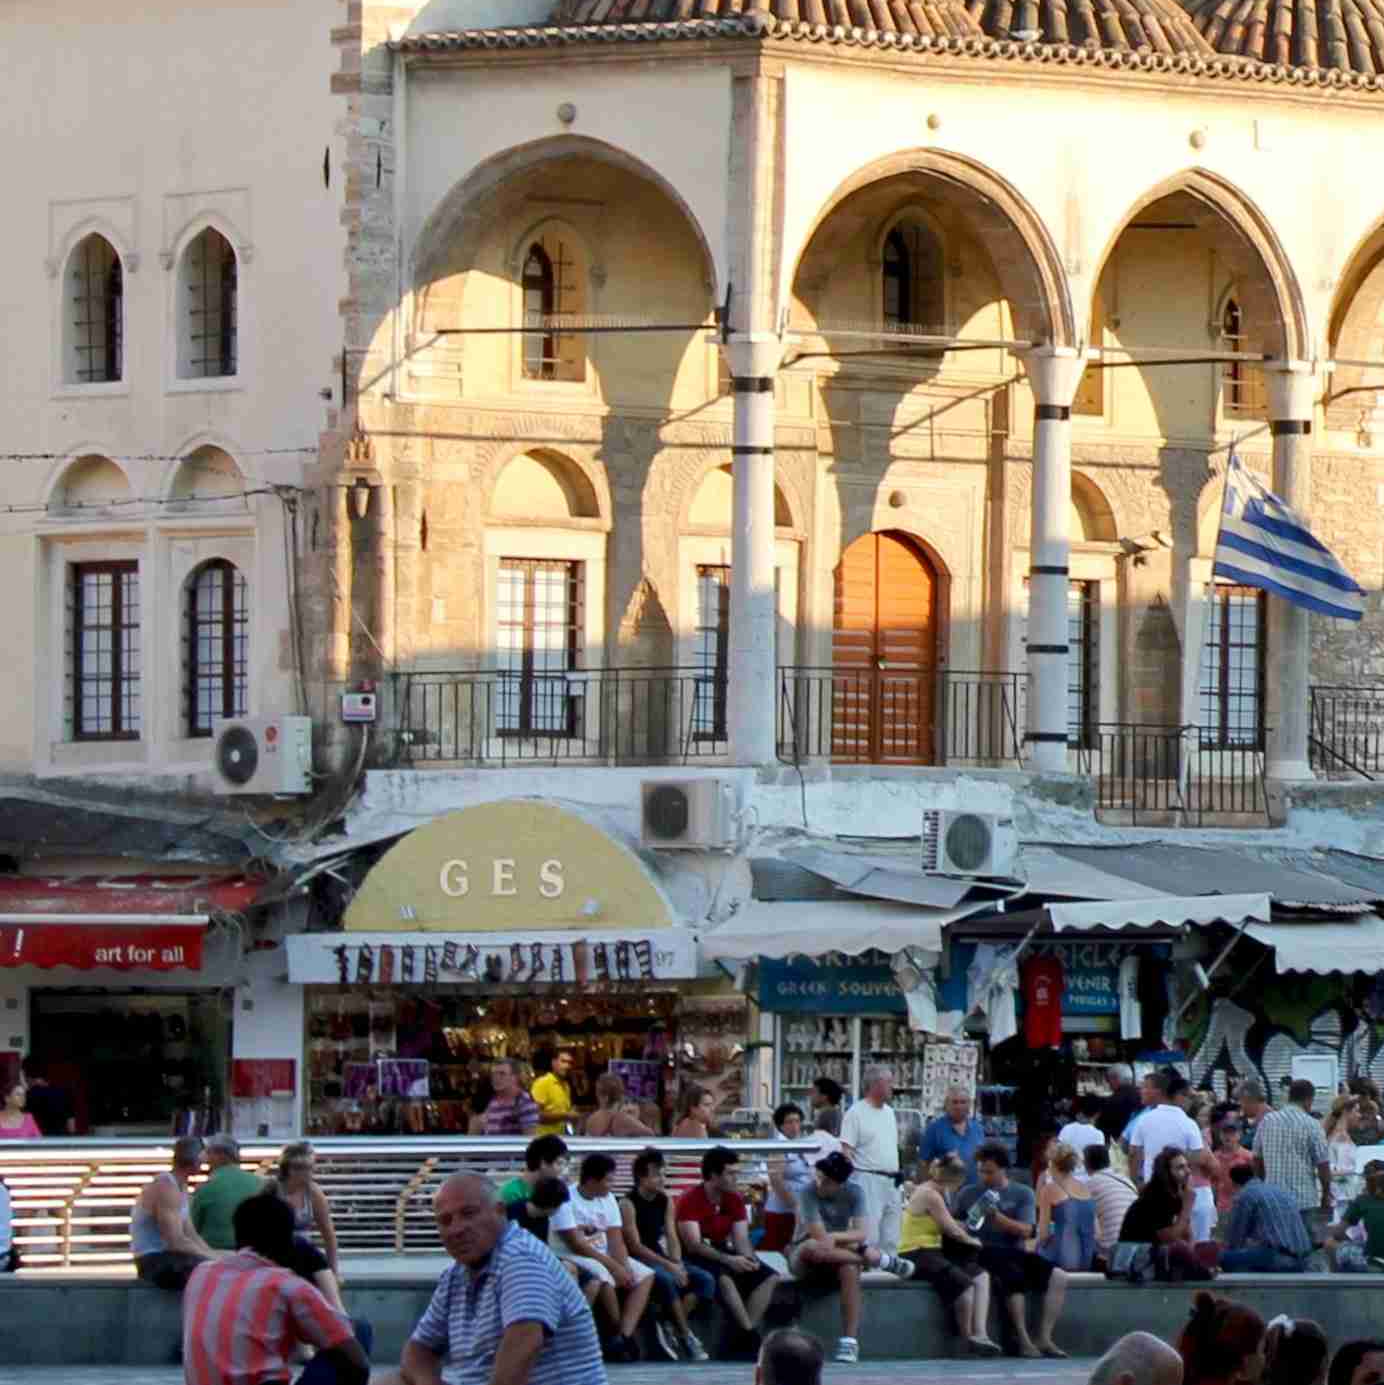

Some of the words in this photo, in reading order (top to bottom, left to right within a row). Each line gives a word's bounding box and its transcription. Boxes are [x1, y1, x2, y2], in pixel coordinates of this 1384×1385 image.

[439, 858, 565, 898] GES
[95, 946, 123, 963] art
[127, 944, 155, 963] for
[161, 945, 184, 963] all
